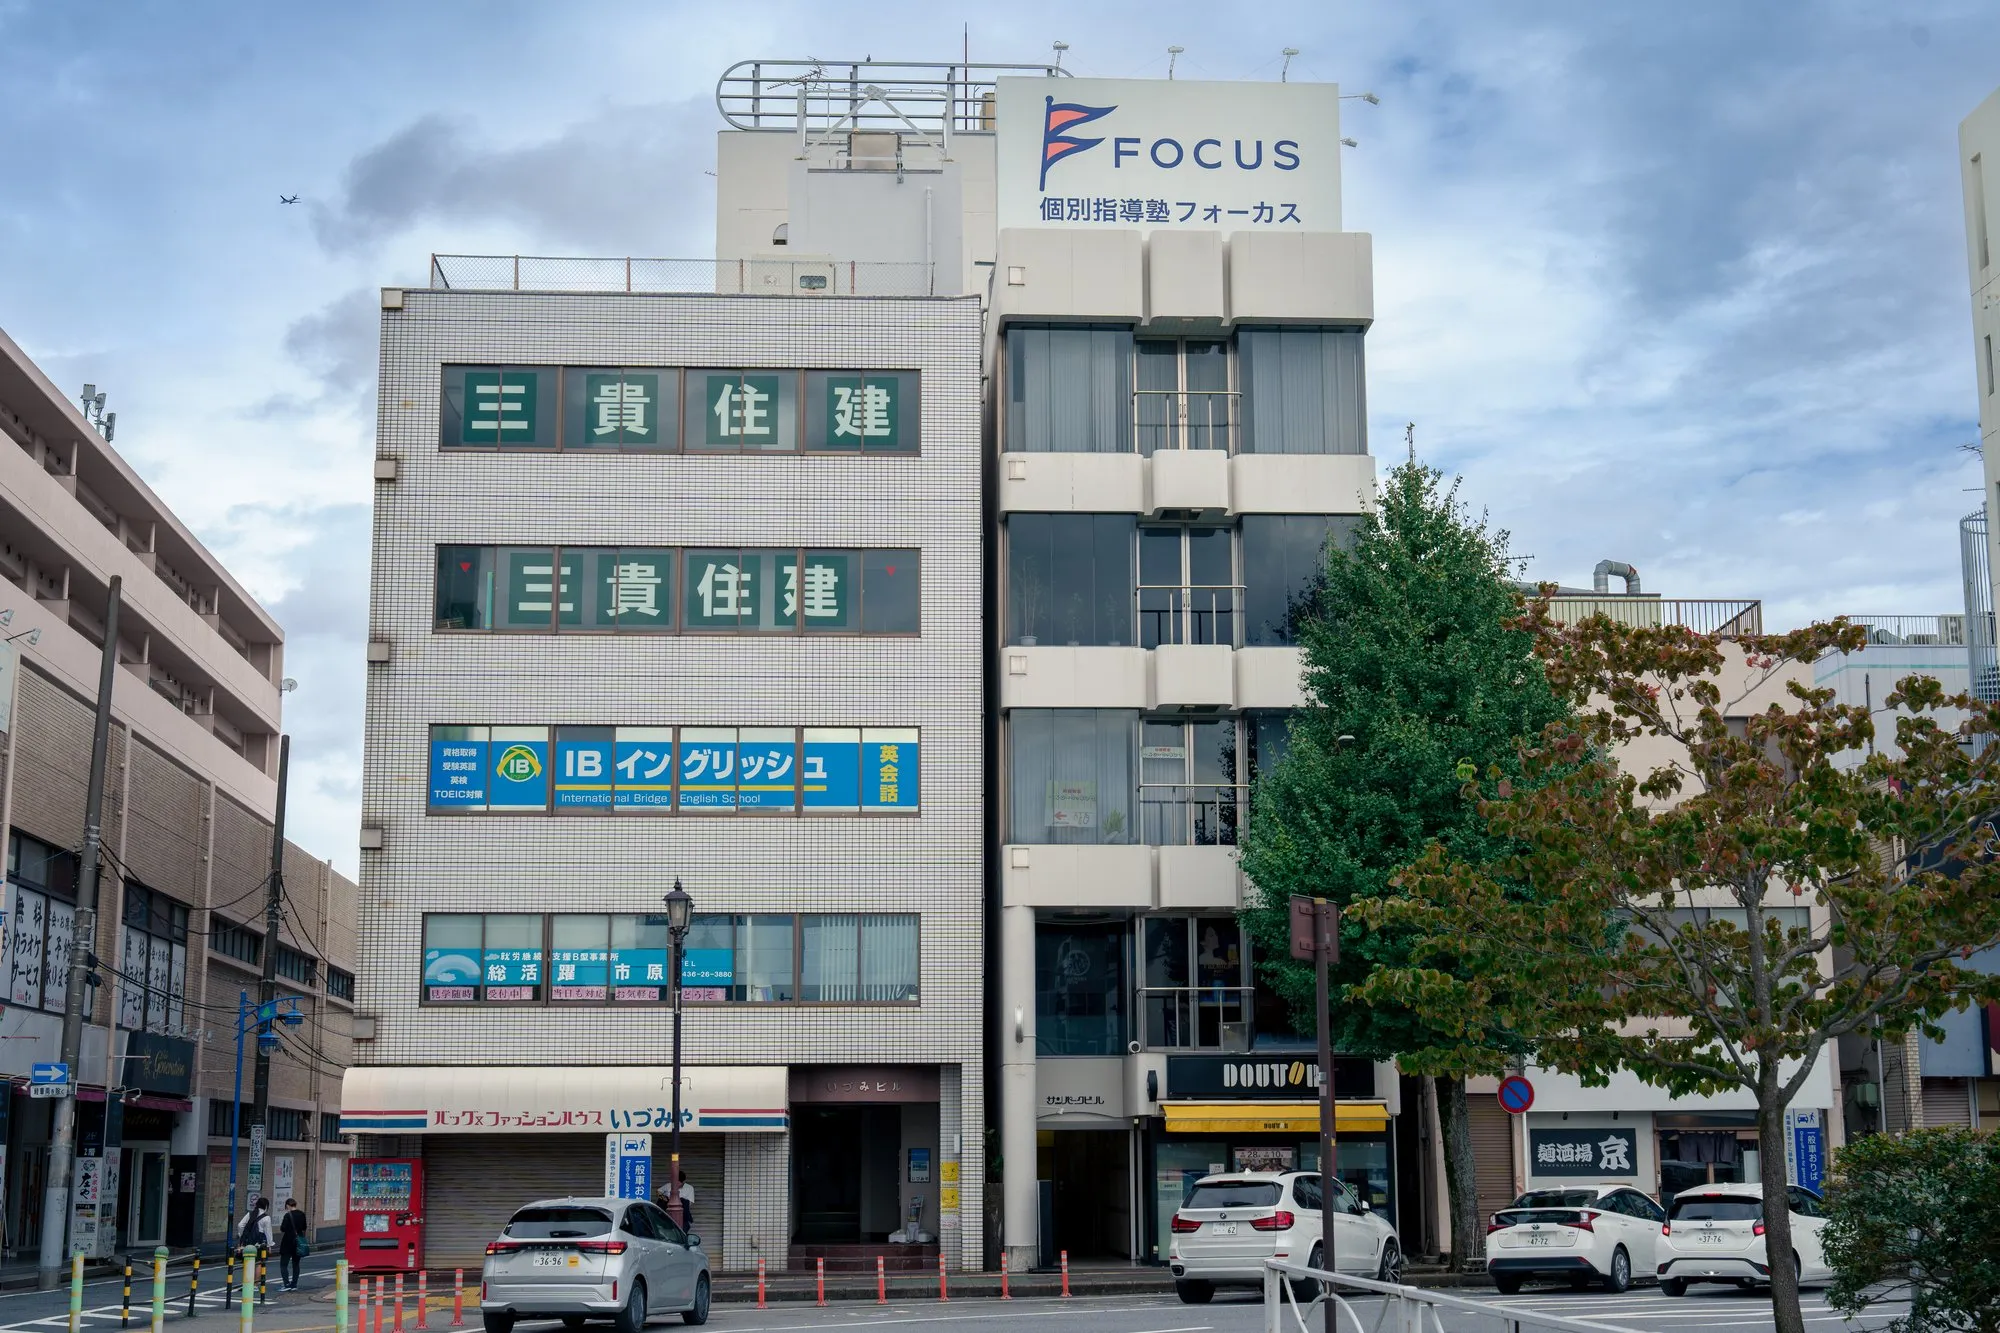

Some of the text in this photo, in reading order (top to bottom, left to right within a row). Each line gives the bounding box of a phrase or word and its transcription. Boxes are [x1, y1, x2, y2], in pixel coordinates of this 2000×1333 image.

[1114, 137, 1300, 171] FOCUS
[1040, 196, 1301, 224] 個別指導塾フォーカス
[471, 382, 891, 437] 三貴住建
[518, 562, 839, 618] 三貴住建
[443, 748, 477, 757] 資格取得
[442, 762, 477, 771] 受験英語
[509, 759, 529, 774] IB
[880, 744, 899, 803] 英会話
[450, 776, 468, 785] 英検
[434, 790, 483, 799] TOEIC対策
[561, 793, 760, 804] International Bridge English School
[826, 1081, 901, 1092] いづみビル
[1597, 1134, 1631, 1171] 京
[1807, 1131, 1819, 1181] 一般車おりば
